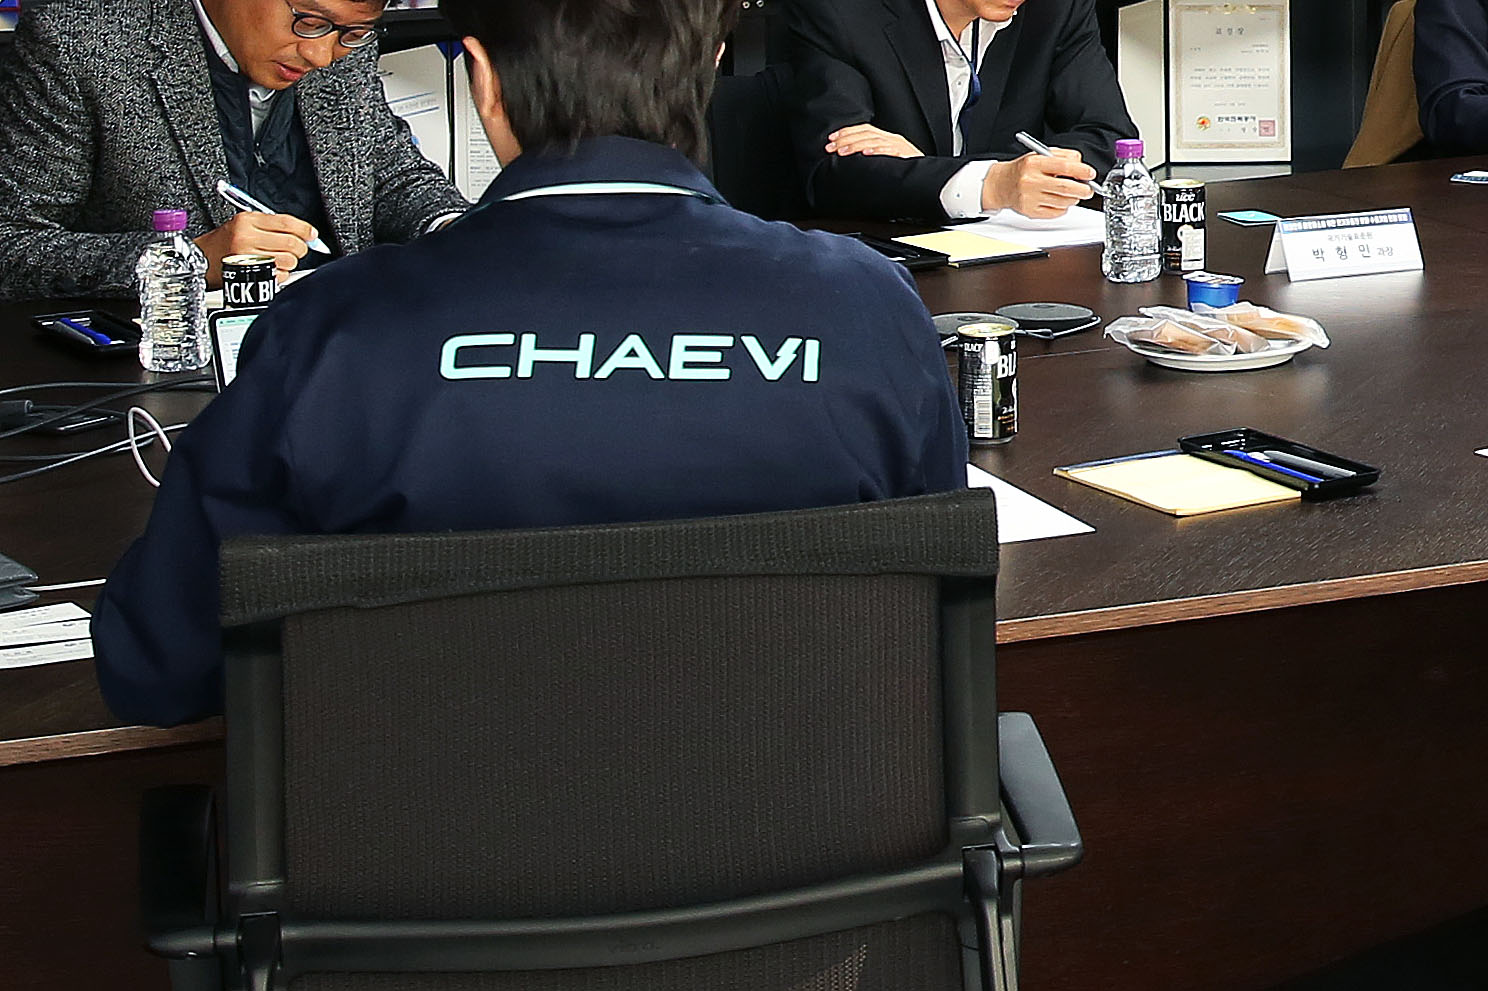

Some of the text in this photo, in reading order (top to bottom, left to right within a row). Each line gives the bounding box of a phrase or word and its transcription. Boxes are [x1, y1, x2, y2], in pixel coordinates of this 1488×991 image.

[1163, 201, 1205, 223] BLACK
[224, 281, 255, 304] ACK
[439, 333, 820, 382] CHAEVI
